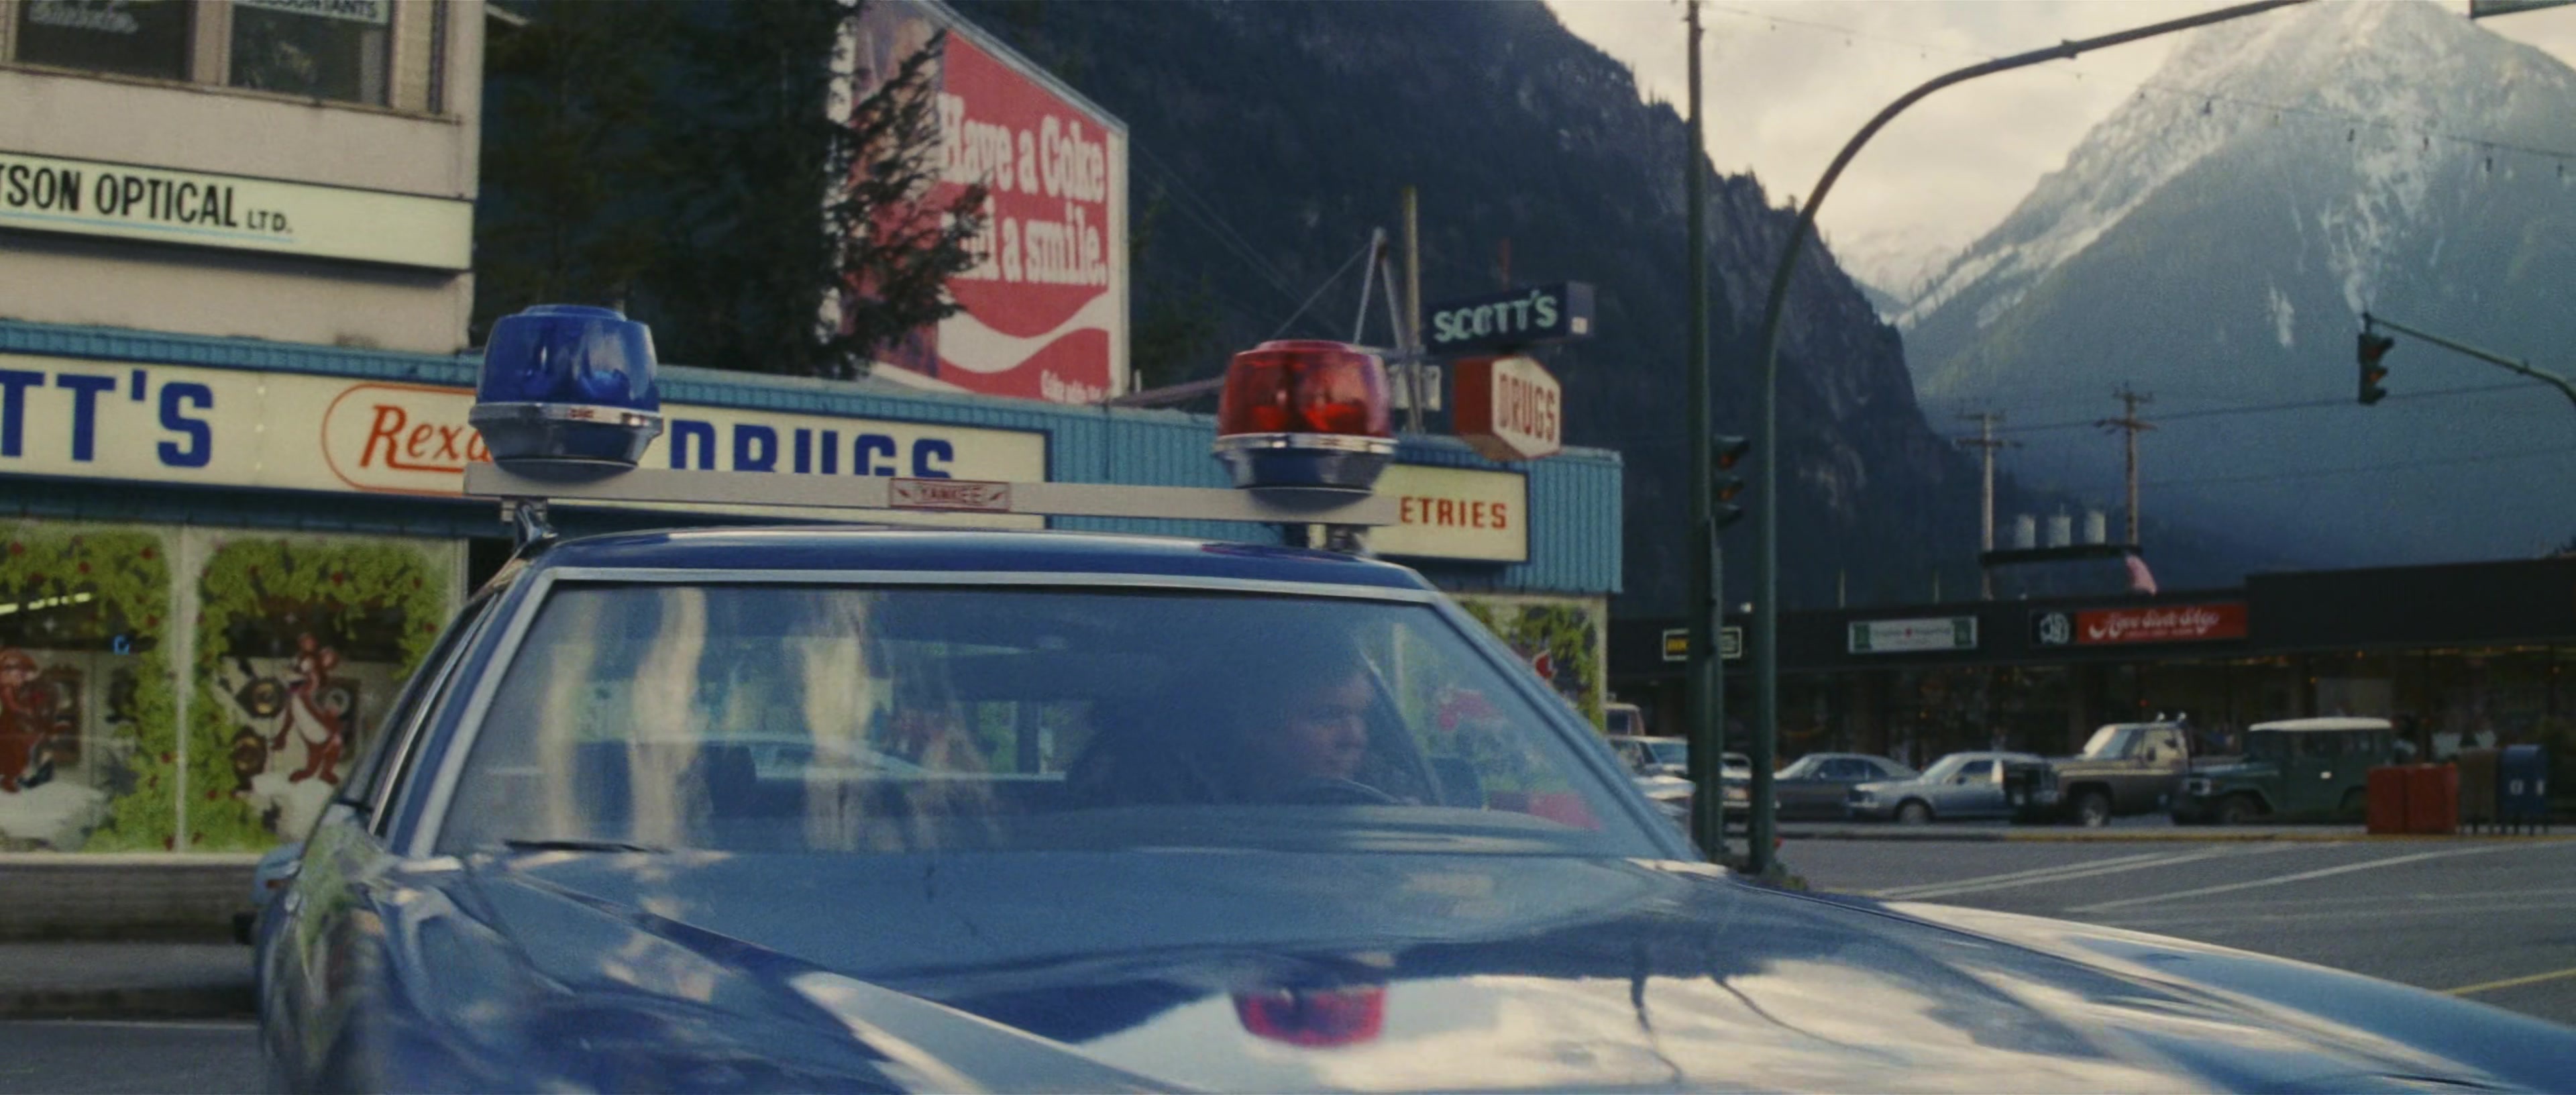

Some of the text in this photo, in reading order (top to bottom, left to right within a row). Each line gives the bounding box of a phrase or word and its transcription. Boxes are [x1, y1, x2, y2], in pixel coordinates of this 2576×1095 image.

[938, 92, 1106, 203] Have a Coke
[0, 165, 293, 233] SON OPTICAL LTD.
[1002, 217, 1022, 282] a
[1024, 200, 1108, 286] smile.
[1434, 289, 1558, 342] SCOTT'S
[0, 368, 214, 468] TT'S
[1499, 372, 1555, 442] DRUGS
[671, 420, 953, 479] DRUGS
